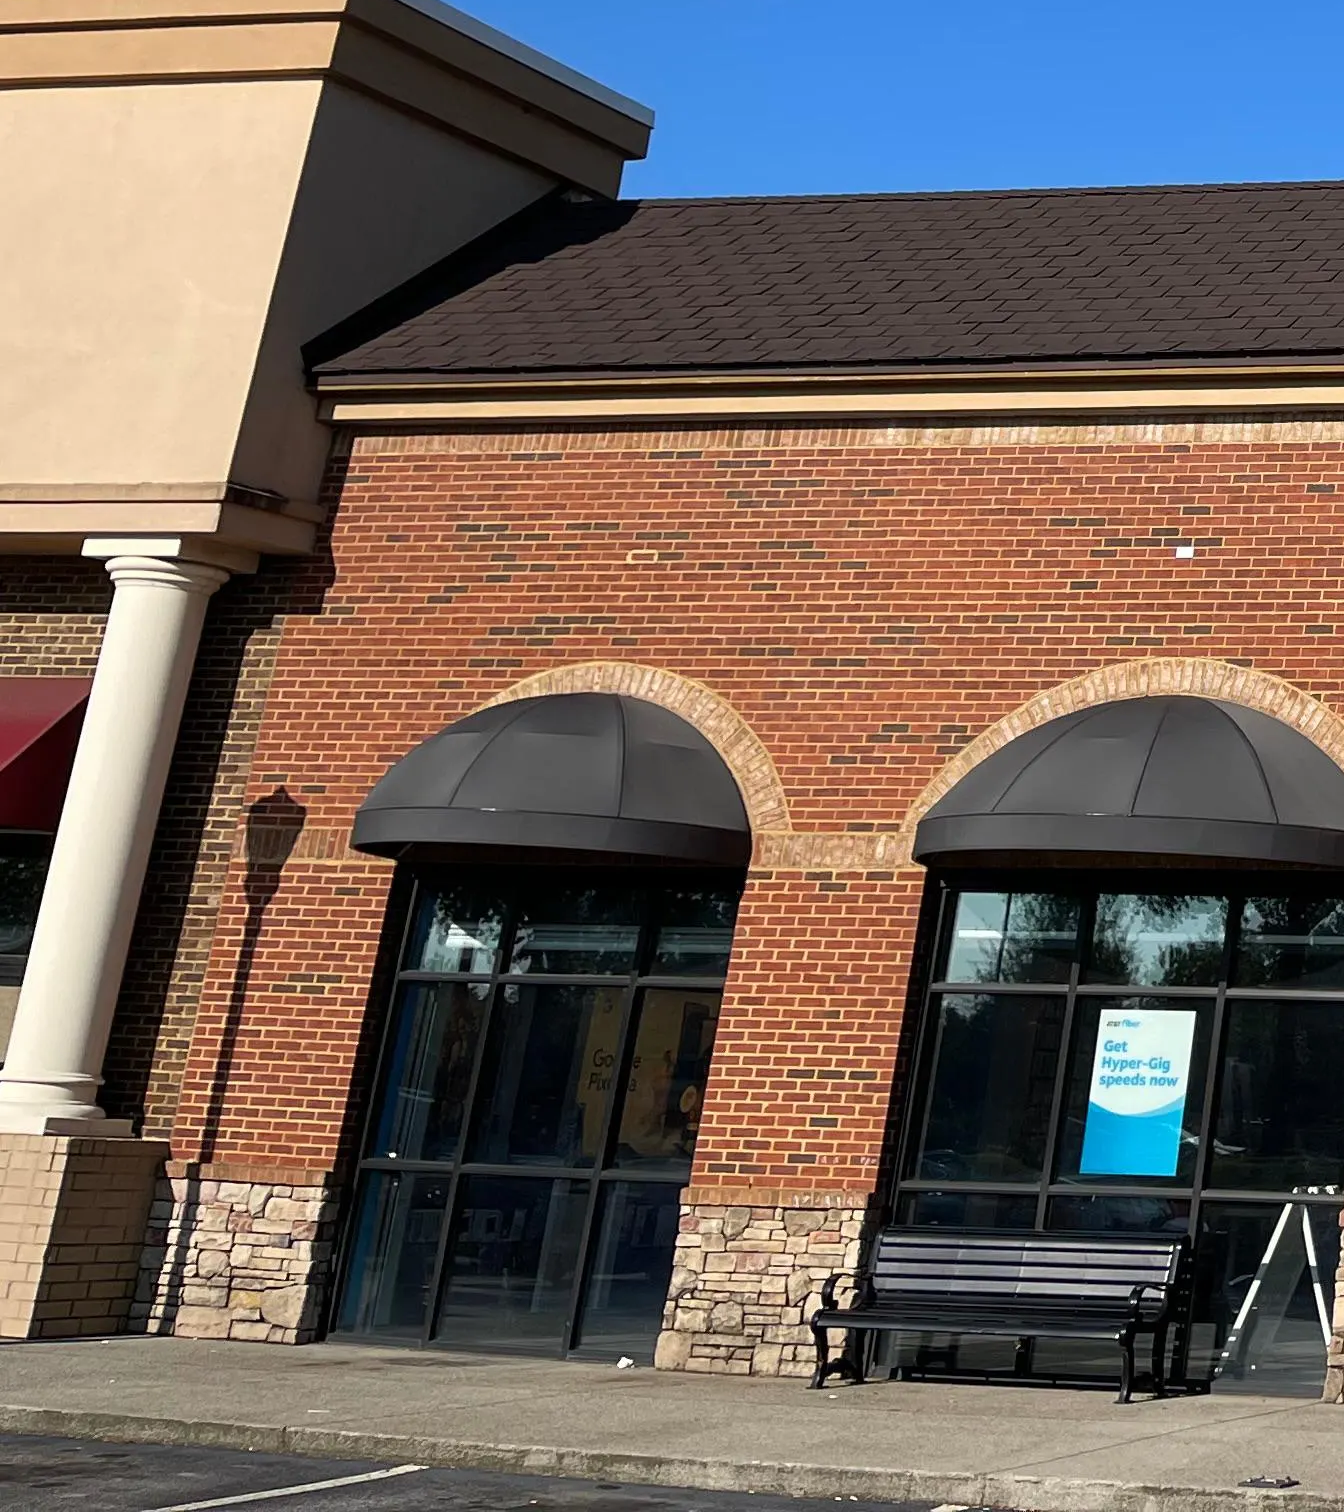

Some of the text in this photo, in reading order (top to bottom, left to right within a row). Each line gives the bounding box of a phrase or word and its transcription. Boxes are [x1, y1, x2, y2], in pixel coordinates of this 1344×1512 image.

[1103, 1040, 1129, 1053] Get
[1101, 1056, 1171, 1074] Hyper-Gig
[1099, 1073, 1180, 1089] speeds now
